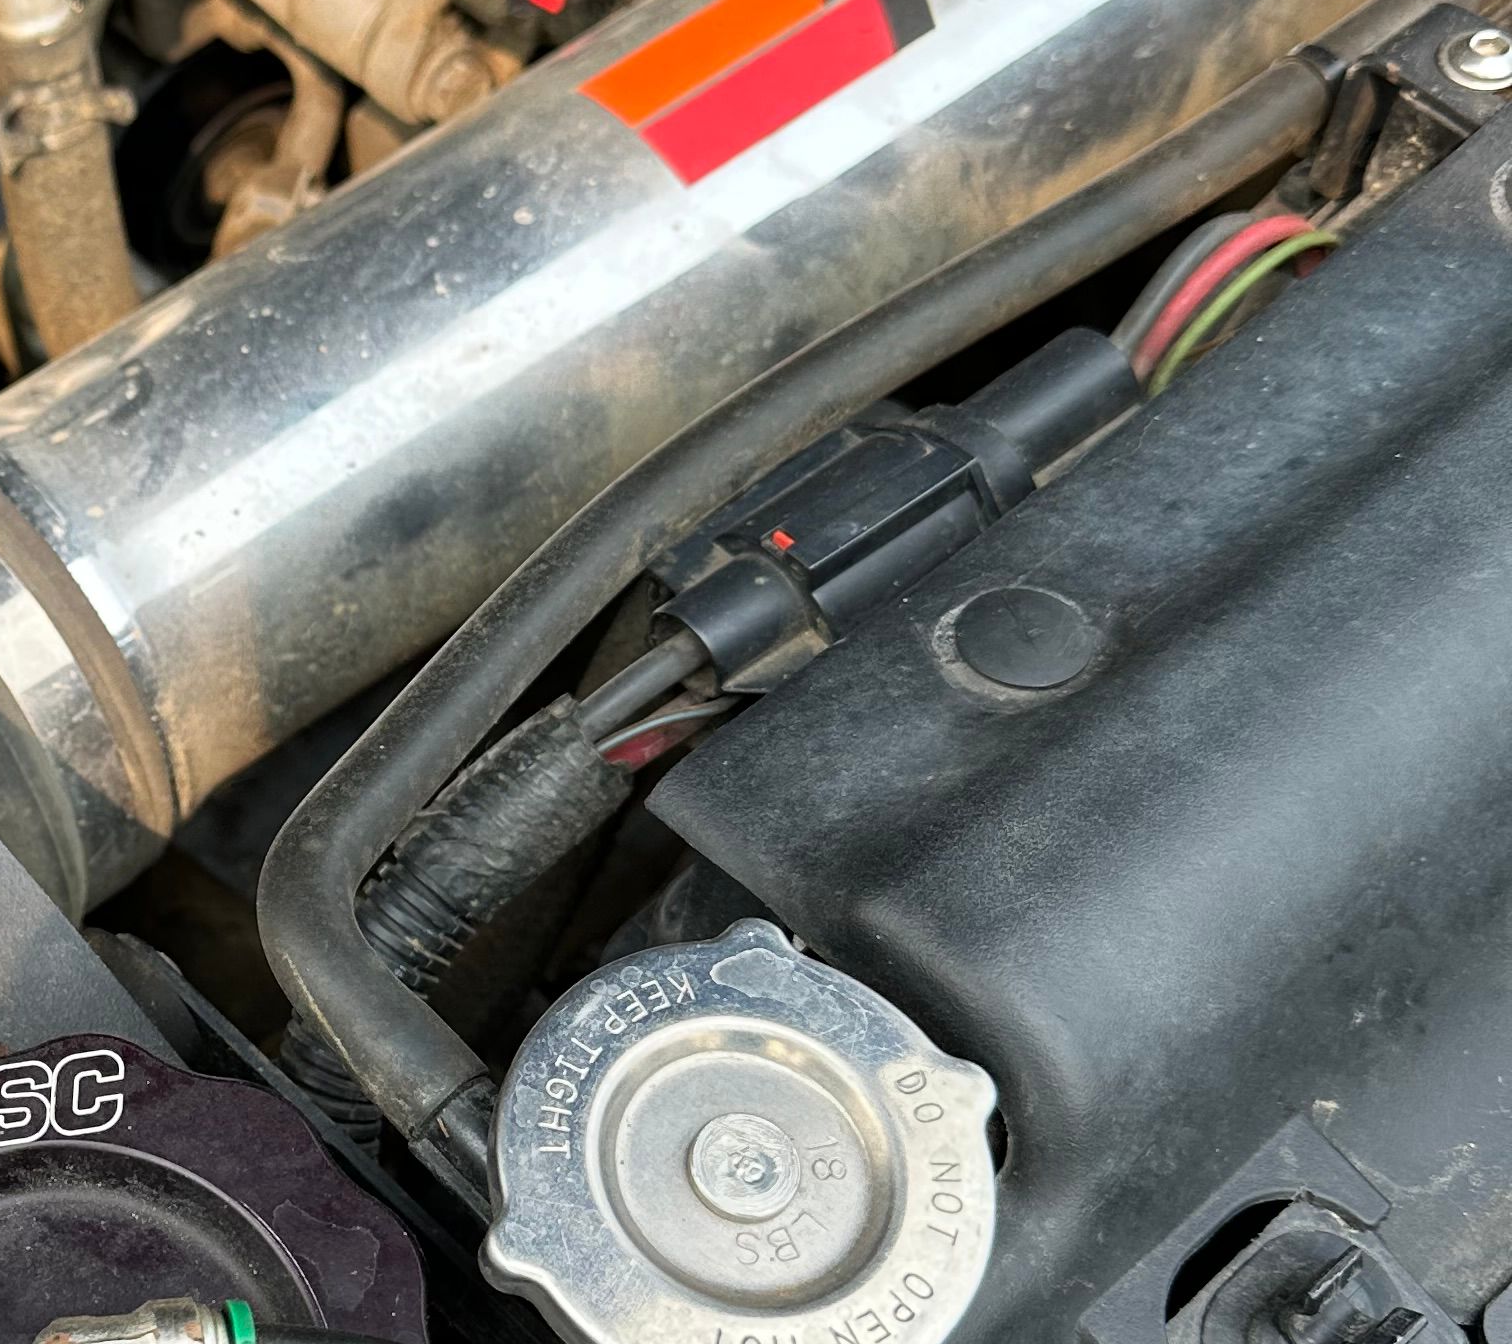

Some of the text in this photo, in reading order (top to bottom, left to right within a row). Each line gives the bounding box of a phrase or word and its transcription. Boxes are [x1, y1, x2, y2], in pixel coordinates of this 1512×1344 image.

[537, 971, 697, 1160] KEEP TIGHT
[806, 1135, 848, 1182] 18
[896, 1069, 945, 1124] DO
[926, 1161, 964, 1247] NOT
